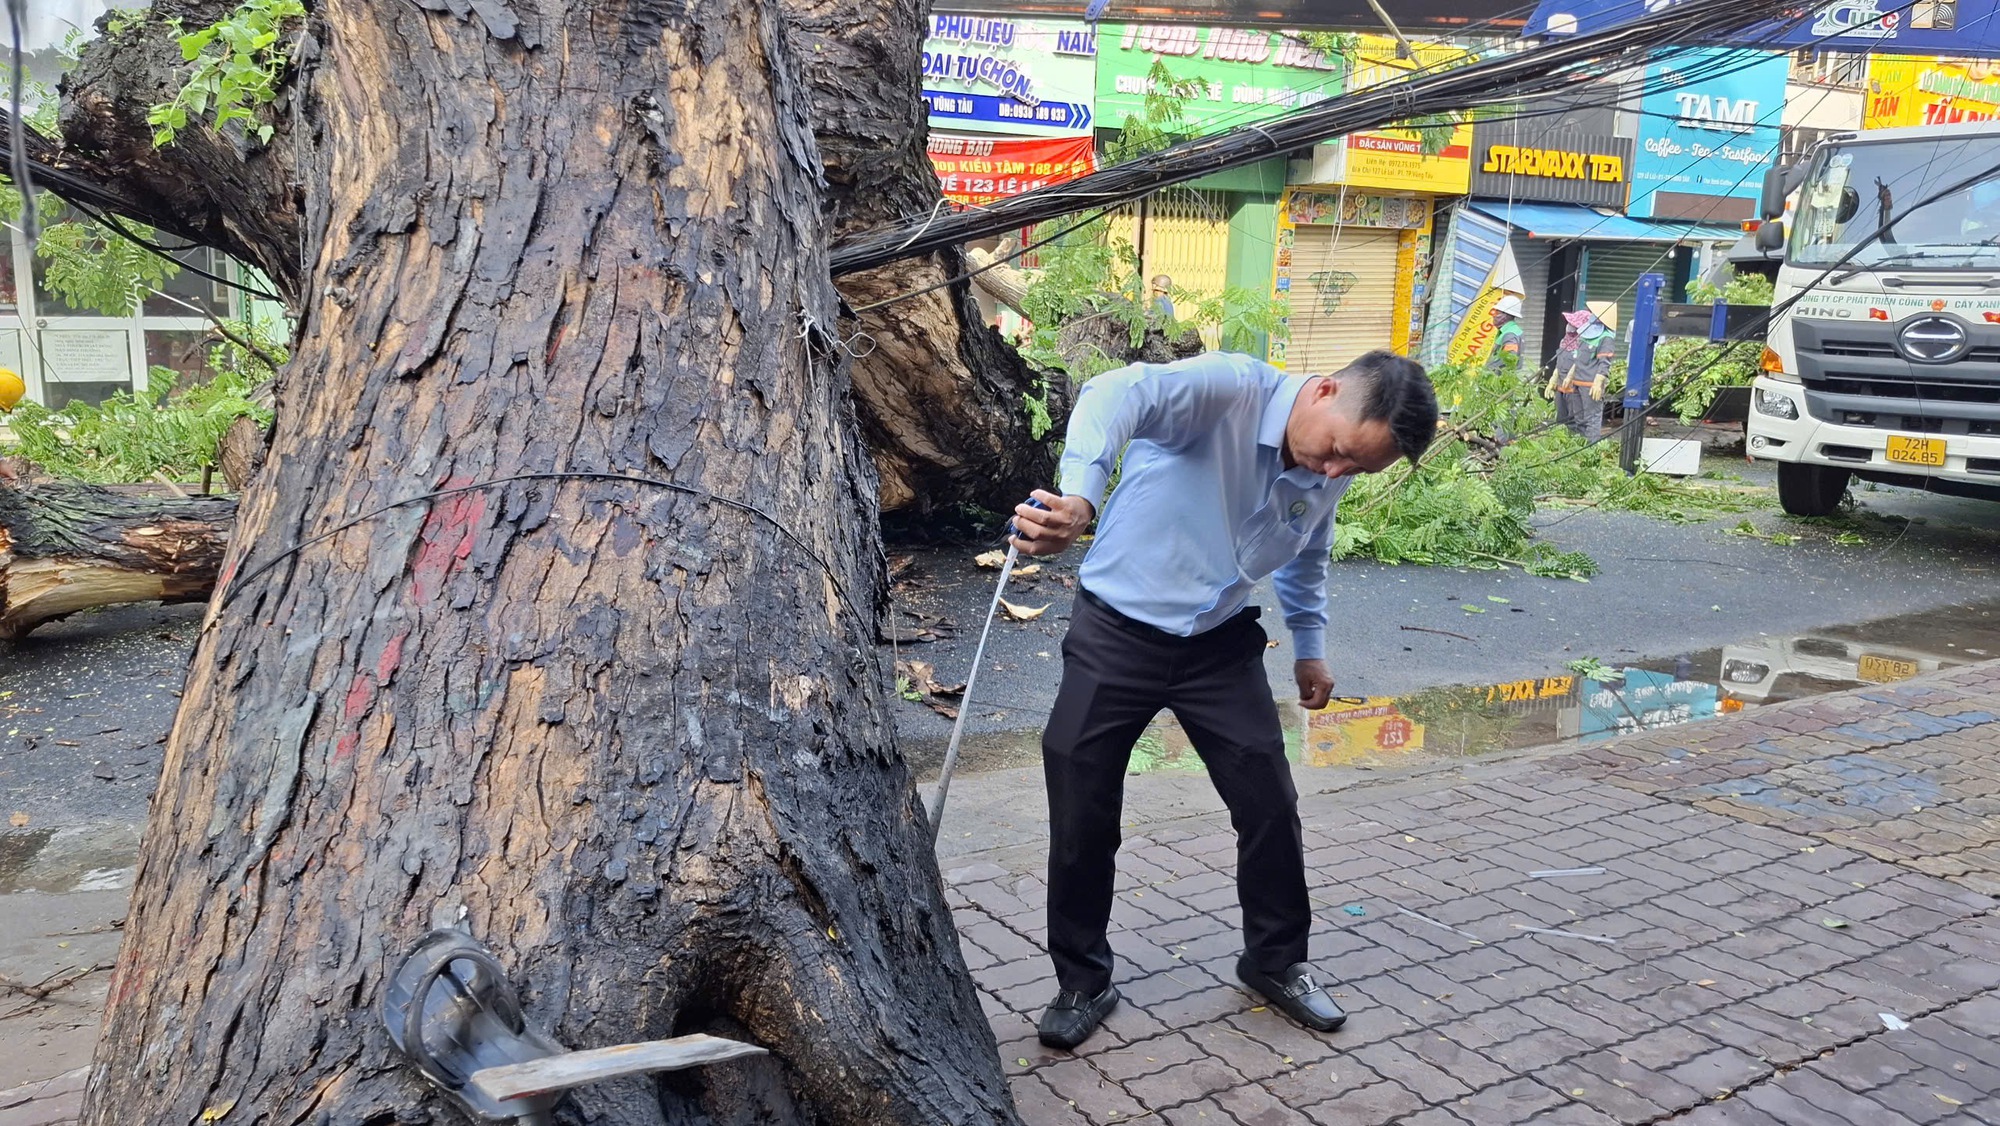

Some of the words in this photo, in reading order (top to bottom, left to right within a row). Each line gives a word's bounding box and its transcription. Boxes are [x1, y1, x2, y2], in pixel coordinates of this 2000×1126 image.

[934, 15, 974, 48] PHỤ
[1056, 30, 1098, 55] NAIL
[921, 51, 952, 83] OẠI
[956, 53, 981, 87] TỰ
[933, 95, 956, 113] VŨNG
[957, 97, 973, 114] TÀU
[1675, 92, 1760, 134] TAMI
[1873, 92, 1900, 118] TẤN
[1359, 139, 1375, 150] ĐẶC
[1376, 140, 1392, 151] SẢN
[1394, 141, 1415, 152] VŨNG
[1645, 137, 1682, 158] Coffee
[1691, 143, 1714, 158] Tea
[1721, 145, 1771, 166] Fastfood
[1483, 144, 1587, 180] STARMAXX
[1589, 153, 1623, 183] TEA
[964, 179, 994, 193] 123
[1821, 295, 1831, 303] TY
[1899, 297, 1923, 307] CÔNG
[1796, 306, 1852, 318] HINO
[1905, 438, 1930, 450] 72H
[1892, 450, 1938, 463] 024.85
